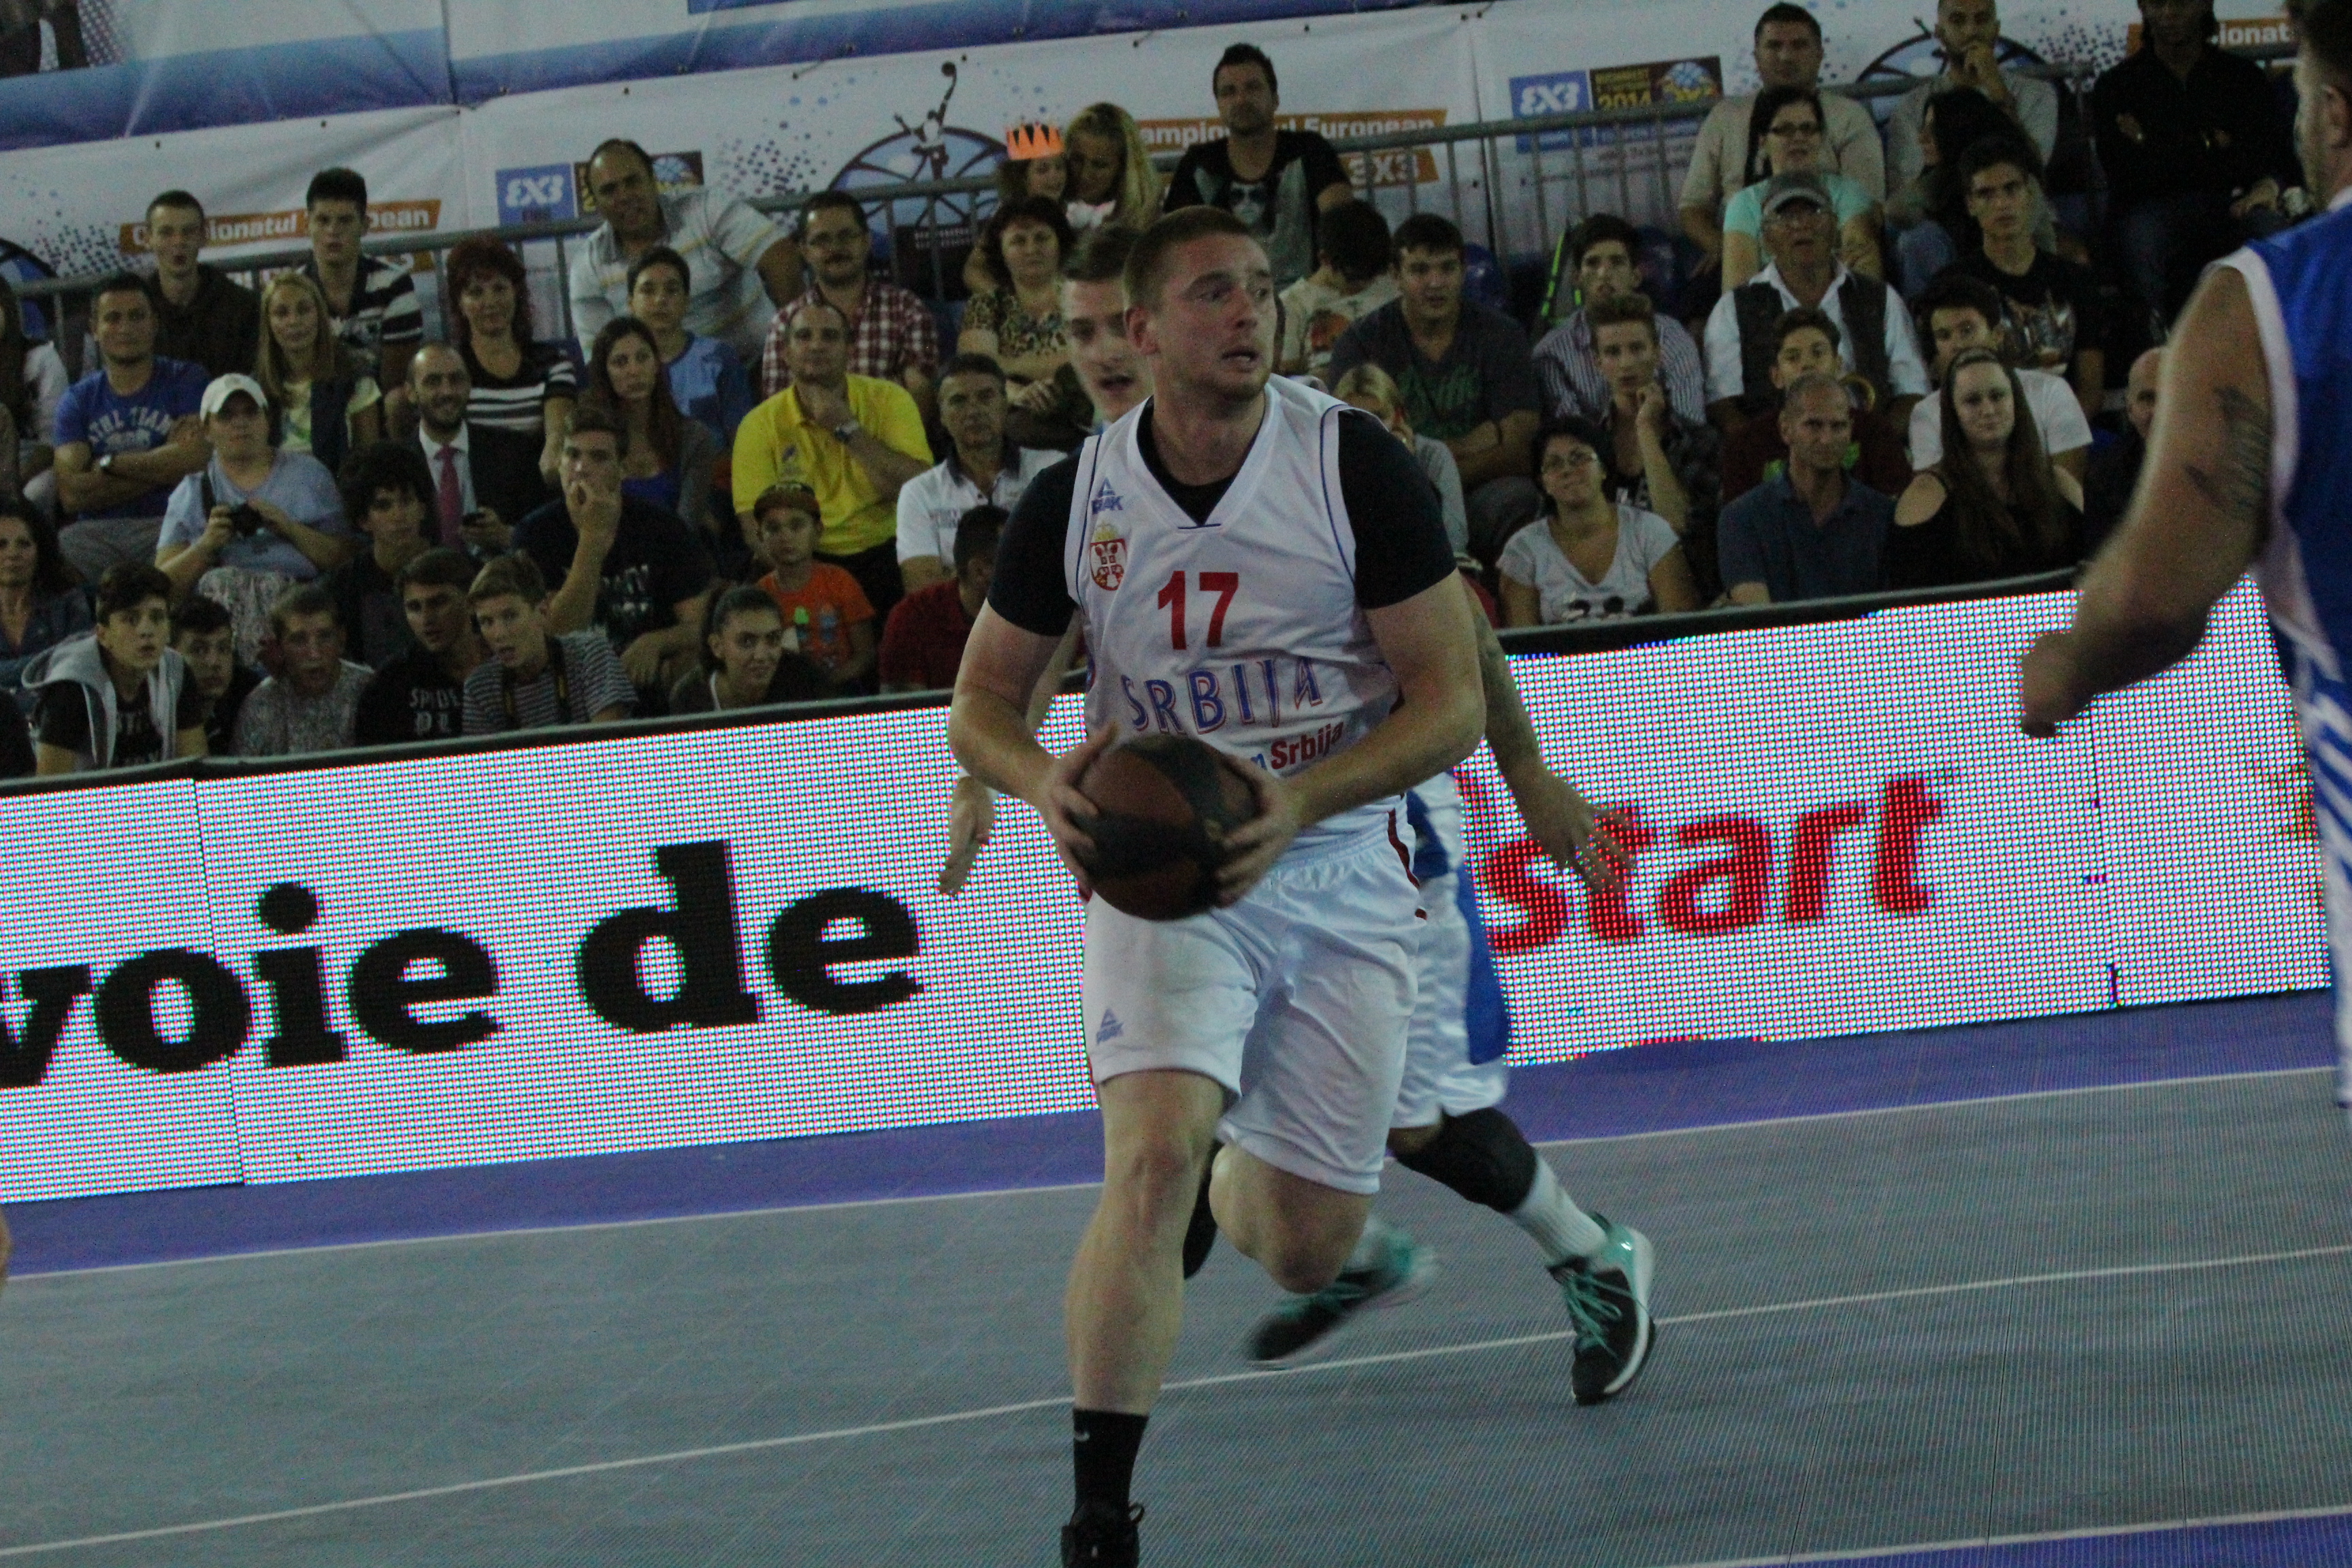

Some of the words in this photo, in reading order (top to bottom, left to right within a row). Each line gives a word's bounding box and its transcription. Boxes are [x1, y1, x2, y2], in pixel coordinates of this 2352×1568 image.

[1157, 570, 1239, 651] 17
[1270, 721, 1345, 770] Srbija
[576, 839, 924, 1034] de
